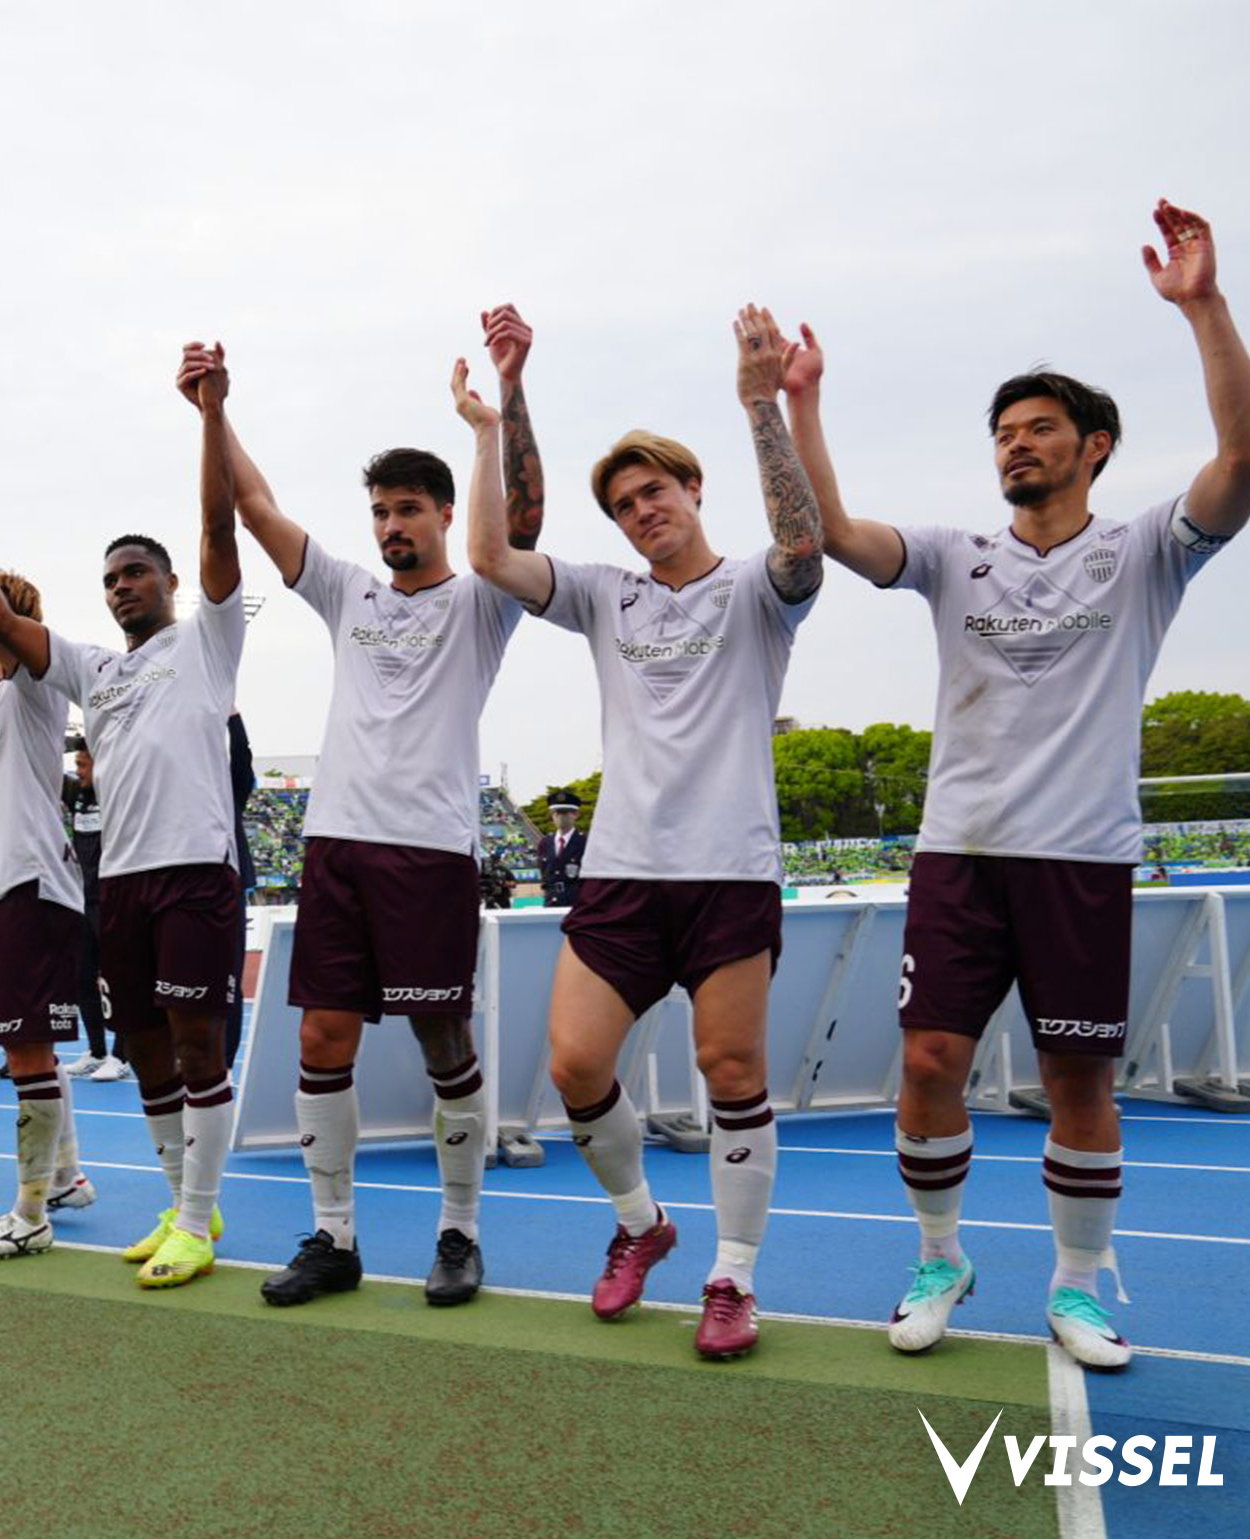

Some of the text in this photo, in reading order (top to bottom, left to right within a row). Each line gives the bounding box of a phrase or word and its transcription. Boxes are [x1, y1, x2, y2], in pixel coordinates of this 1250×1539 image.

[964, 614, 1042, 638] Rakuten
[675, 636, 724, 655] Mobe
[898, 954, 915, 1010] 6
[382, 985, 463, 1001] エクスショップ
